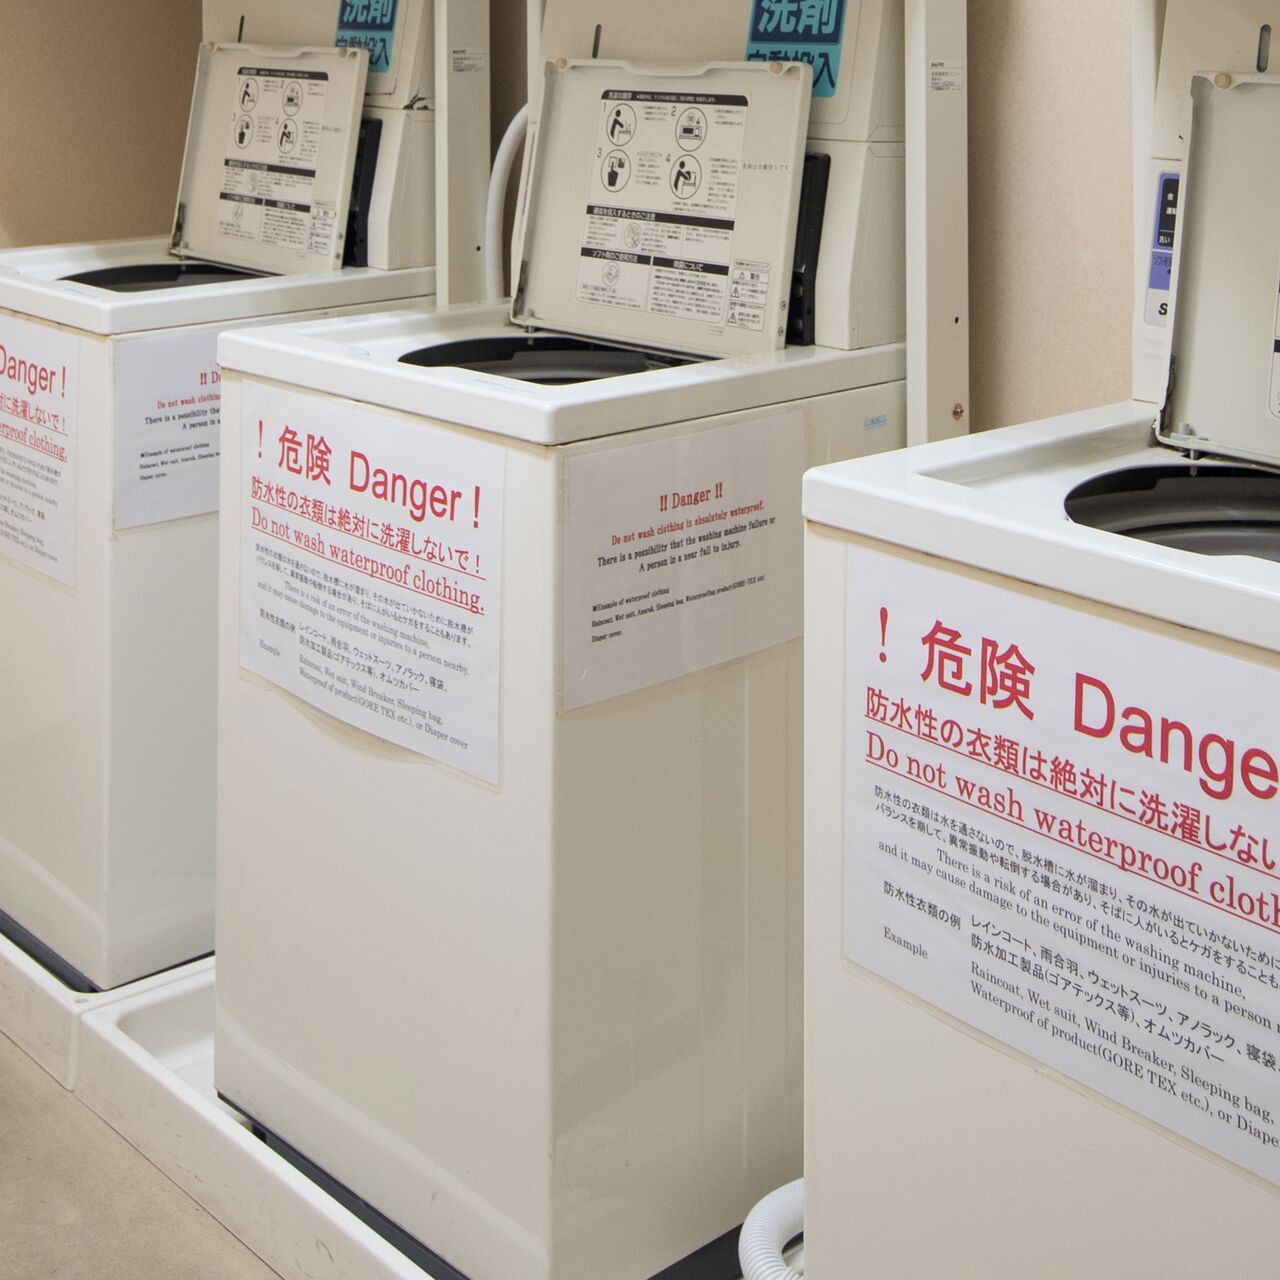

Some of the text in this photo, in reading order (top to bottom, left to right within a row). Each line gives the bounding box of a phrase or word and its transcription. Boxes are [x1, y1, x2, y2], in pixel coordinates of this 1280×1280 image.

[28, 428, 68, 462] clothing.
[277, 425, 333, 486] 危険
[611, 499, 764, 546] Do not wash clothing is absolutely waterproof.
[671, 488, 712, 511] Danger
[251, 506, 485, 617] Do not wash waterproof clothing.
[920, 619, 1037, 722] 危険
[865, 730, 900, 770] Do
[904, 746, 948, 790] not
[954, 775, 1026, 824] wash
[1033, 807, 1202, 894] waterproof
[878, 840, 898, 857] and
[899, 847, 909, 862] it
[910, 855, 934, 873] may
[935, 867, 967, 889] cause
[968, 879, 1013, 911] damage
[1015, 902, 1028, 917] to
[1030, 908, 1050, 927] the
[1052, 921, 1119, 960] equipment
[1121, 953, 1136, 968] or
[1138, 960, 1191, 992] injuries
[1193, 983, 1208, 1000] to
[1210, 994, 1220, 1006] a
[1223, 999, 1272, 1030] person
[883, 880, 961, 931] 防水性衣類の例
[883, 925, 929, 960] Example
[935, 847, 969, 873] There
[970, 867, 981, 879] is
[983, 873, 991, 884] a
[993, 876, 1016, 896] risk
[1018, 888, 1032, 902] of
[1032, 895, 1048, 910] an
[1050, 903, 1083, 925] error
[1084, 918, 1099, 932] of
[1100, 923, 1121, 943] the
[1124, 936, 1180, 972] washing
[969, 979, 1036, 1024] Waterproof
[1036, 1016, 1050, 1031] of
[1146, 1068, 1178, 1097] TEX
[1216, 1109, 1233, 1124] or
[970, 960, 1274, 1125] Raincoat, Wet suit, Wind Breaker, Sleeping bag,
